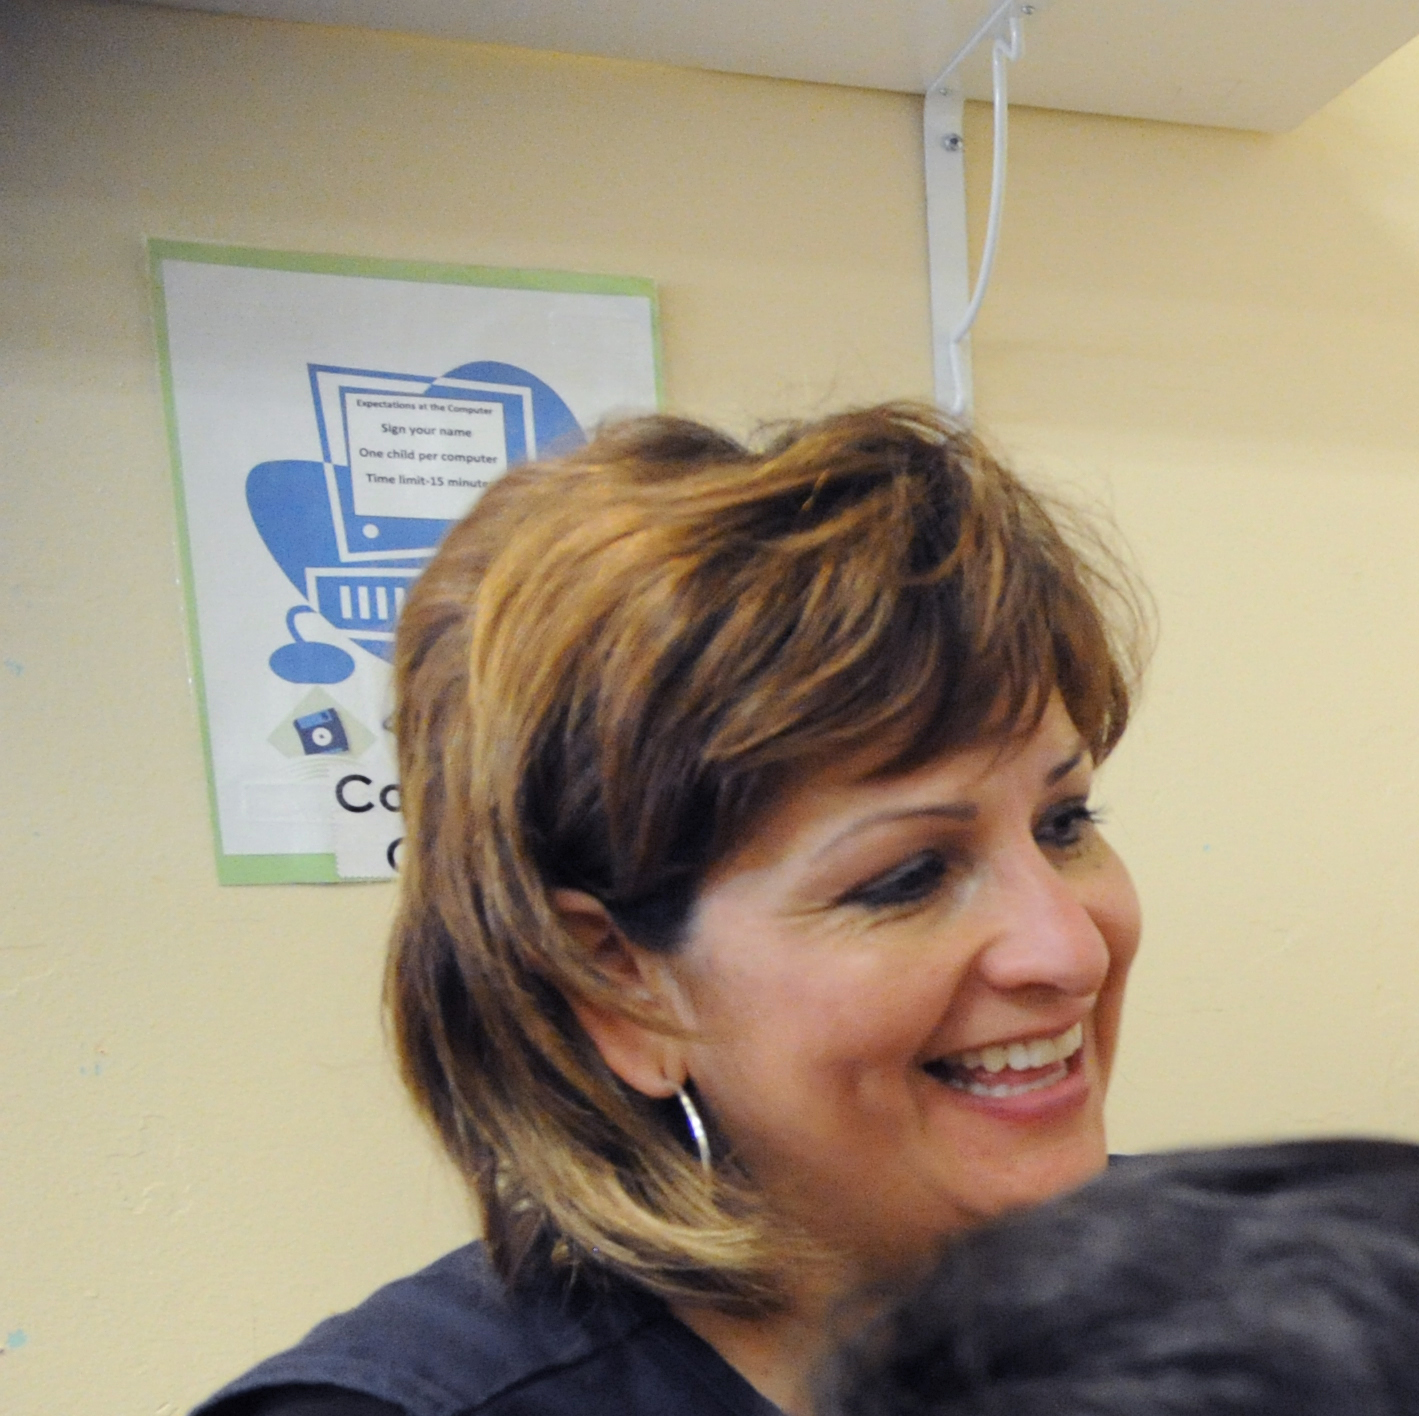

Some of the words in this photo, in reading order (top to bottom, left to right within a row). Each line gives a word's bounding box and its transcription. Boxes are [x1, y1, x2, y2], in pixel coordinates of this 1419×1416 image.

[356, 399, 416, 410] Expectations
[430, 403, 445, 411] the
[447, 404, 493, 415] Computer
[381, 423, 406, 435] Sign
[409, 427, 437, 437] your
[439, 428, 472, 437] name
[359, 447, 384, 458] One
[386, 450, 415, 460] child
[418, 453, 438, 462] per
[441, 454, 497, 464] computer
[366, 473, 395, 484] Time
[398, 475, 444, 487] limit-15
[447, 478, 494, 488] minute
